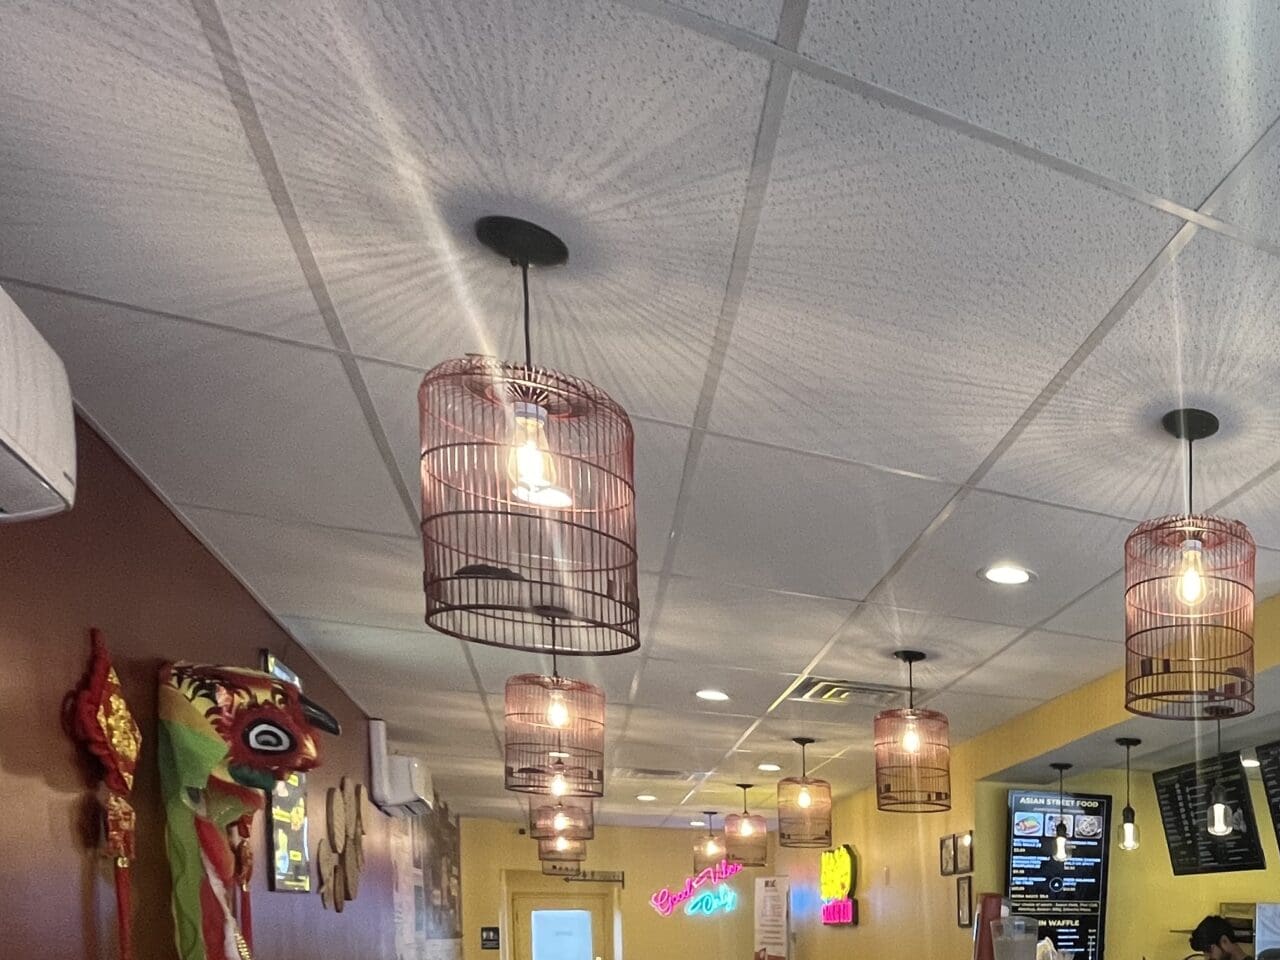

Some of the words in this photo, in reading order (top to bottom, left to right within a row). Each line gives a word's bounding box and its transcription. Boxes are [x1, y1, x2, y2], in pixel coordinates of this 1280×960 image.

[1019, 797, 1045, 805] ASIAN
[1046, 798, 1075, 807] STREET
[1076, 800, 1099, 808] FOOD
[651, 878, 694, 917] Good
[1048, 919, 1080, 927] WAFFLE
